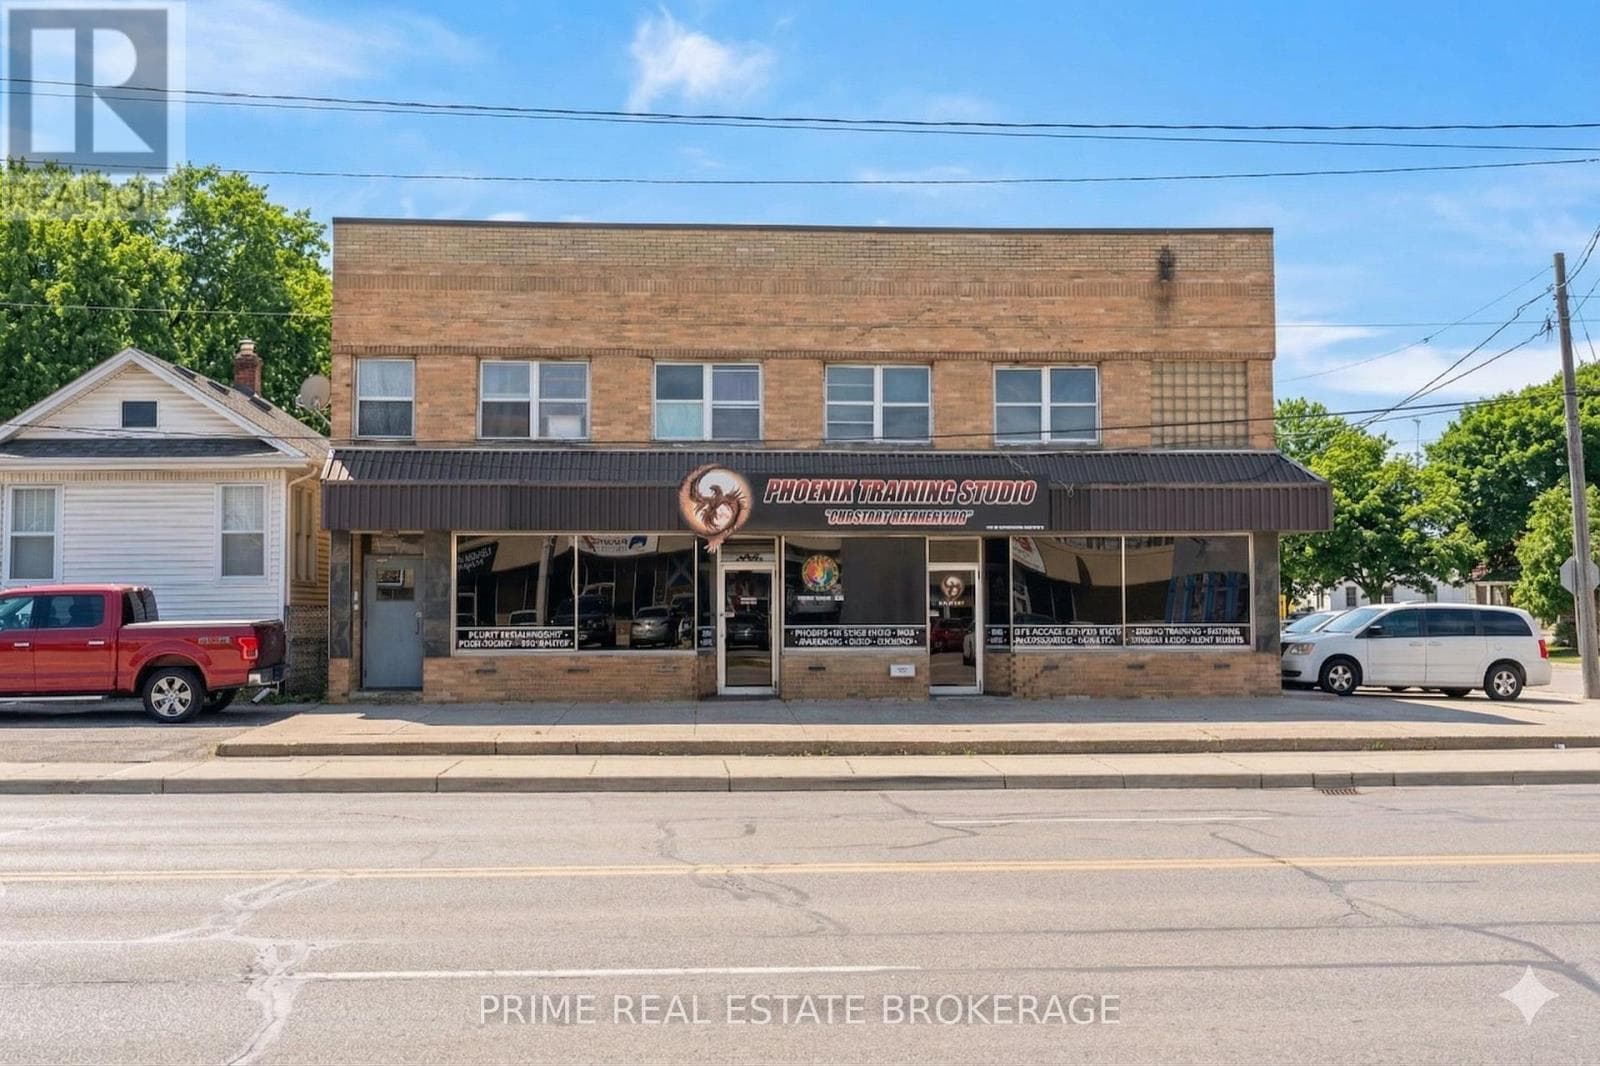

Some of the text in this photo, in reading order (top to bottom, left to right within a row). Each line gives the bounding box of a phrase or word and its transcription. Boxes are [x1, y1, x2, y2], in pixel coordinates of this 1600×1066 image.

[763, 478, 1037, 505] PHOENIX TRAINING STUDIO
